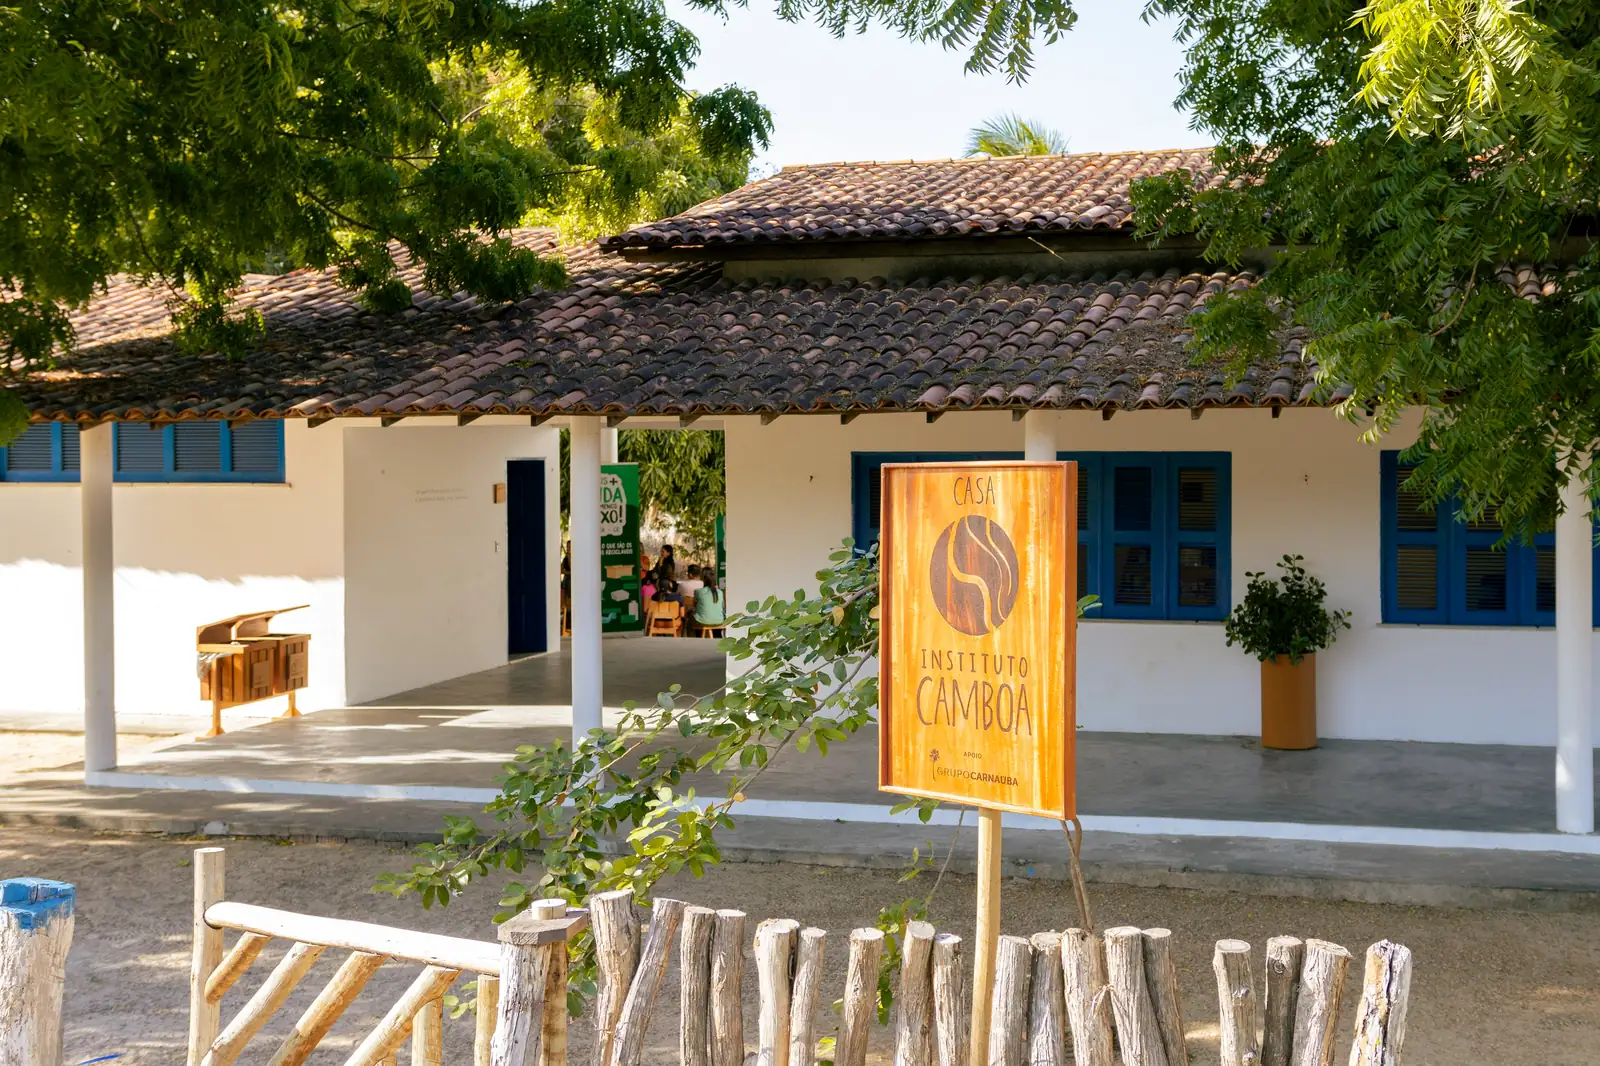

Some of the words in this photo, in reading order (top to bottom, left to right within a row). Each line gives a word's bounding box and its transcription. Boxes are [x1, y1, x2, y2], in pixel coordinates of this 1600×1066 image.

[953, 476, 996, 506] CASA
[921, 648, 1028, 678] INSTITUTO
[916, 675, 1033, 736] CAMBOA
[963, 751, 983, 760] APOIO
